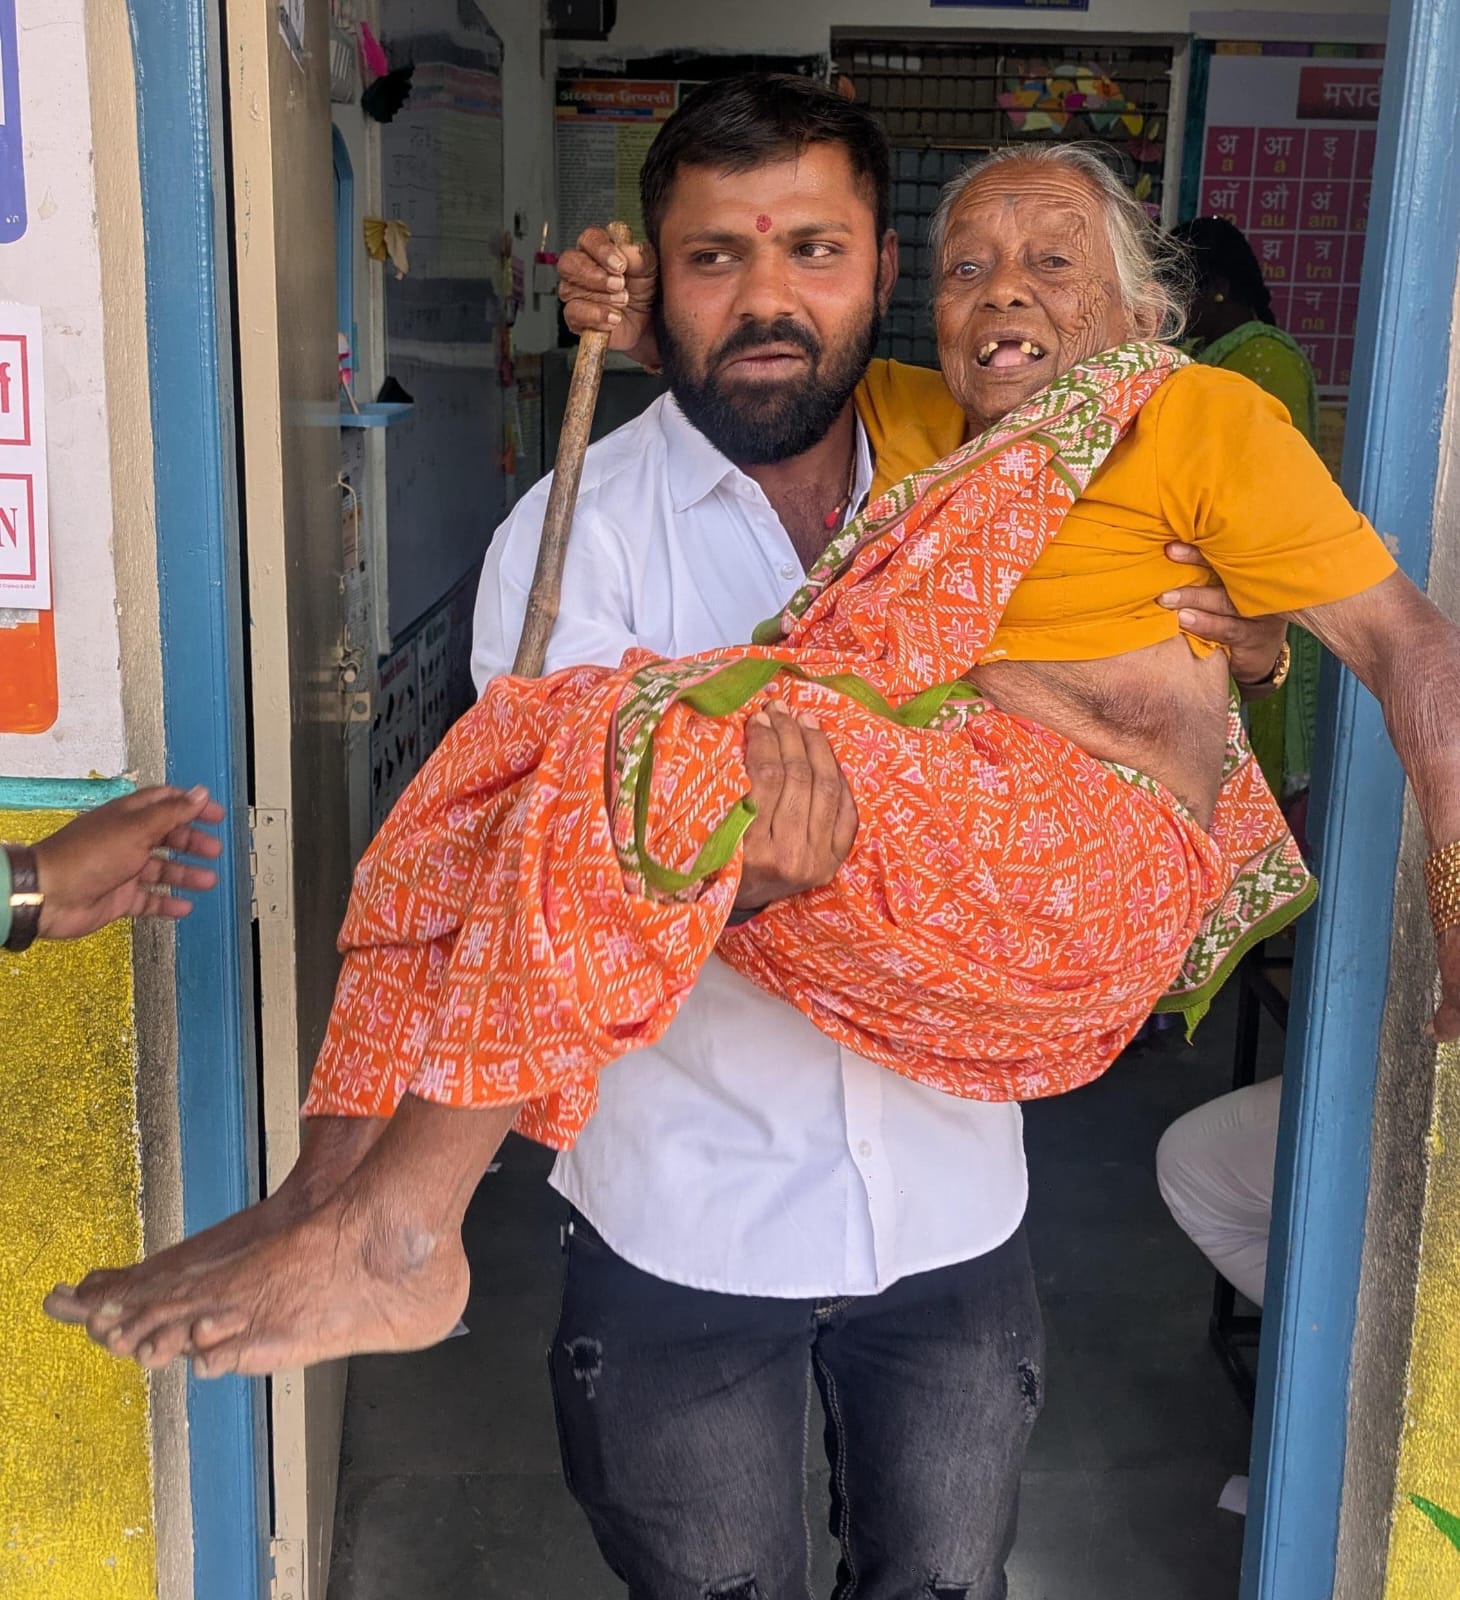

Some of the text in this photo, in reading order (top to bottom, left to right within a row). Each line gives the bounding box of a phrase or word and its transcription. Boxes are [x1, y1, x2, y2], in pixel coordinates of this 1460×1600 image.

[1217, 134, 1338, 161] अ आ इ
[1222, 158, 1233, 171] a
[1273, 159, 1286, 173] a
[1259, 183, 1289, 210] औ
[1311, 184, 1333, 211] अं
[1260, 214, 1285, 228] au
[1308, 215, 1338, 228] am
[1306, 262, 1332, 279] tra
[1304, 291, 1323, 311] न
[1301, 317, 1325, 331] na
